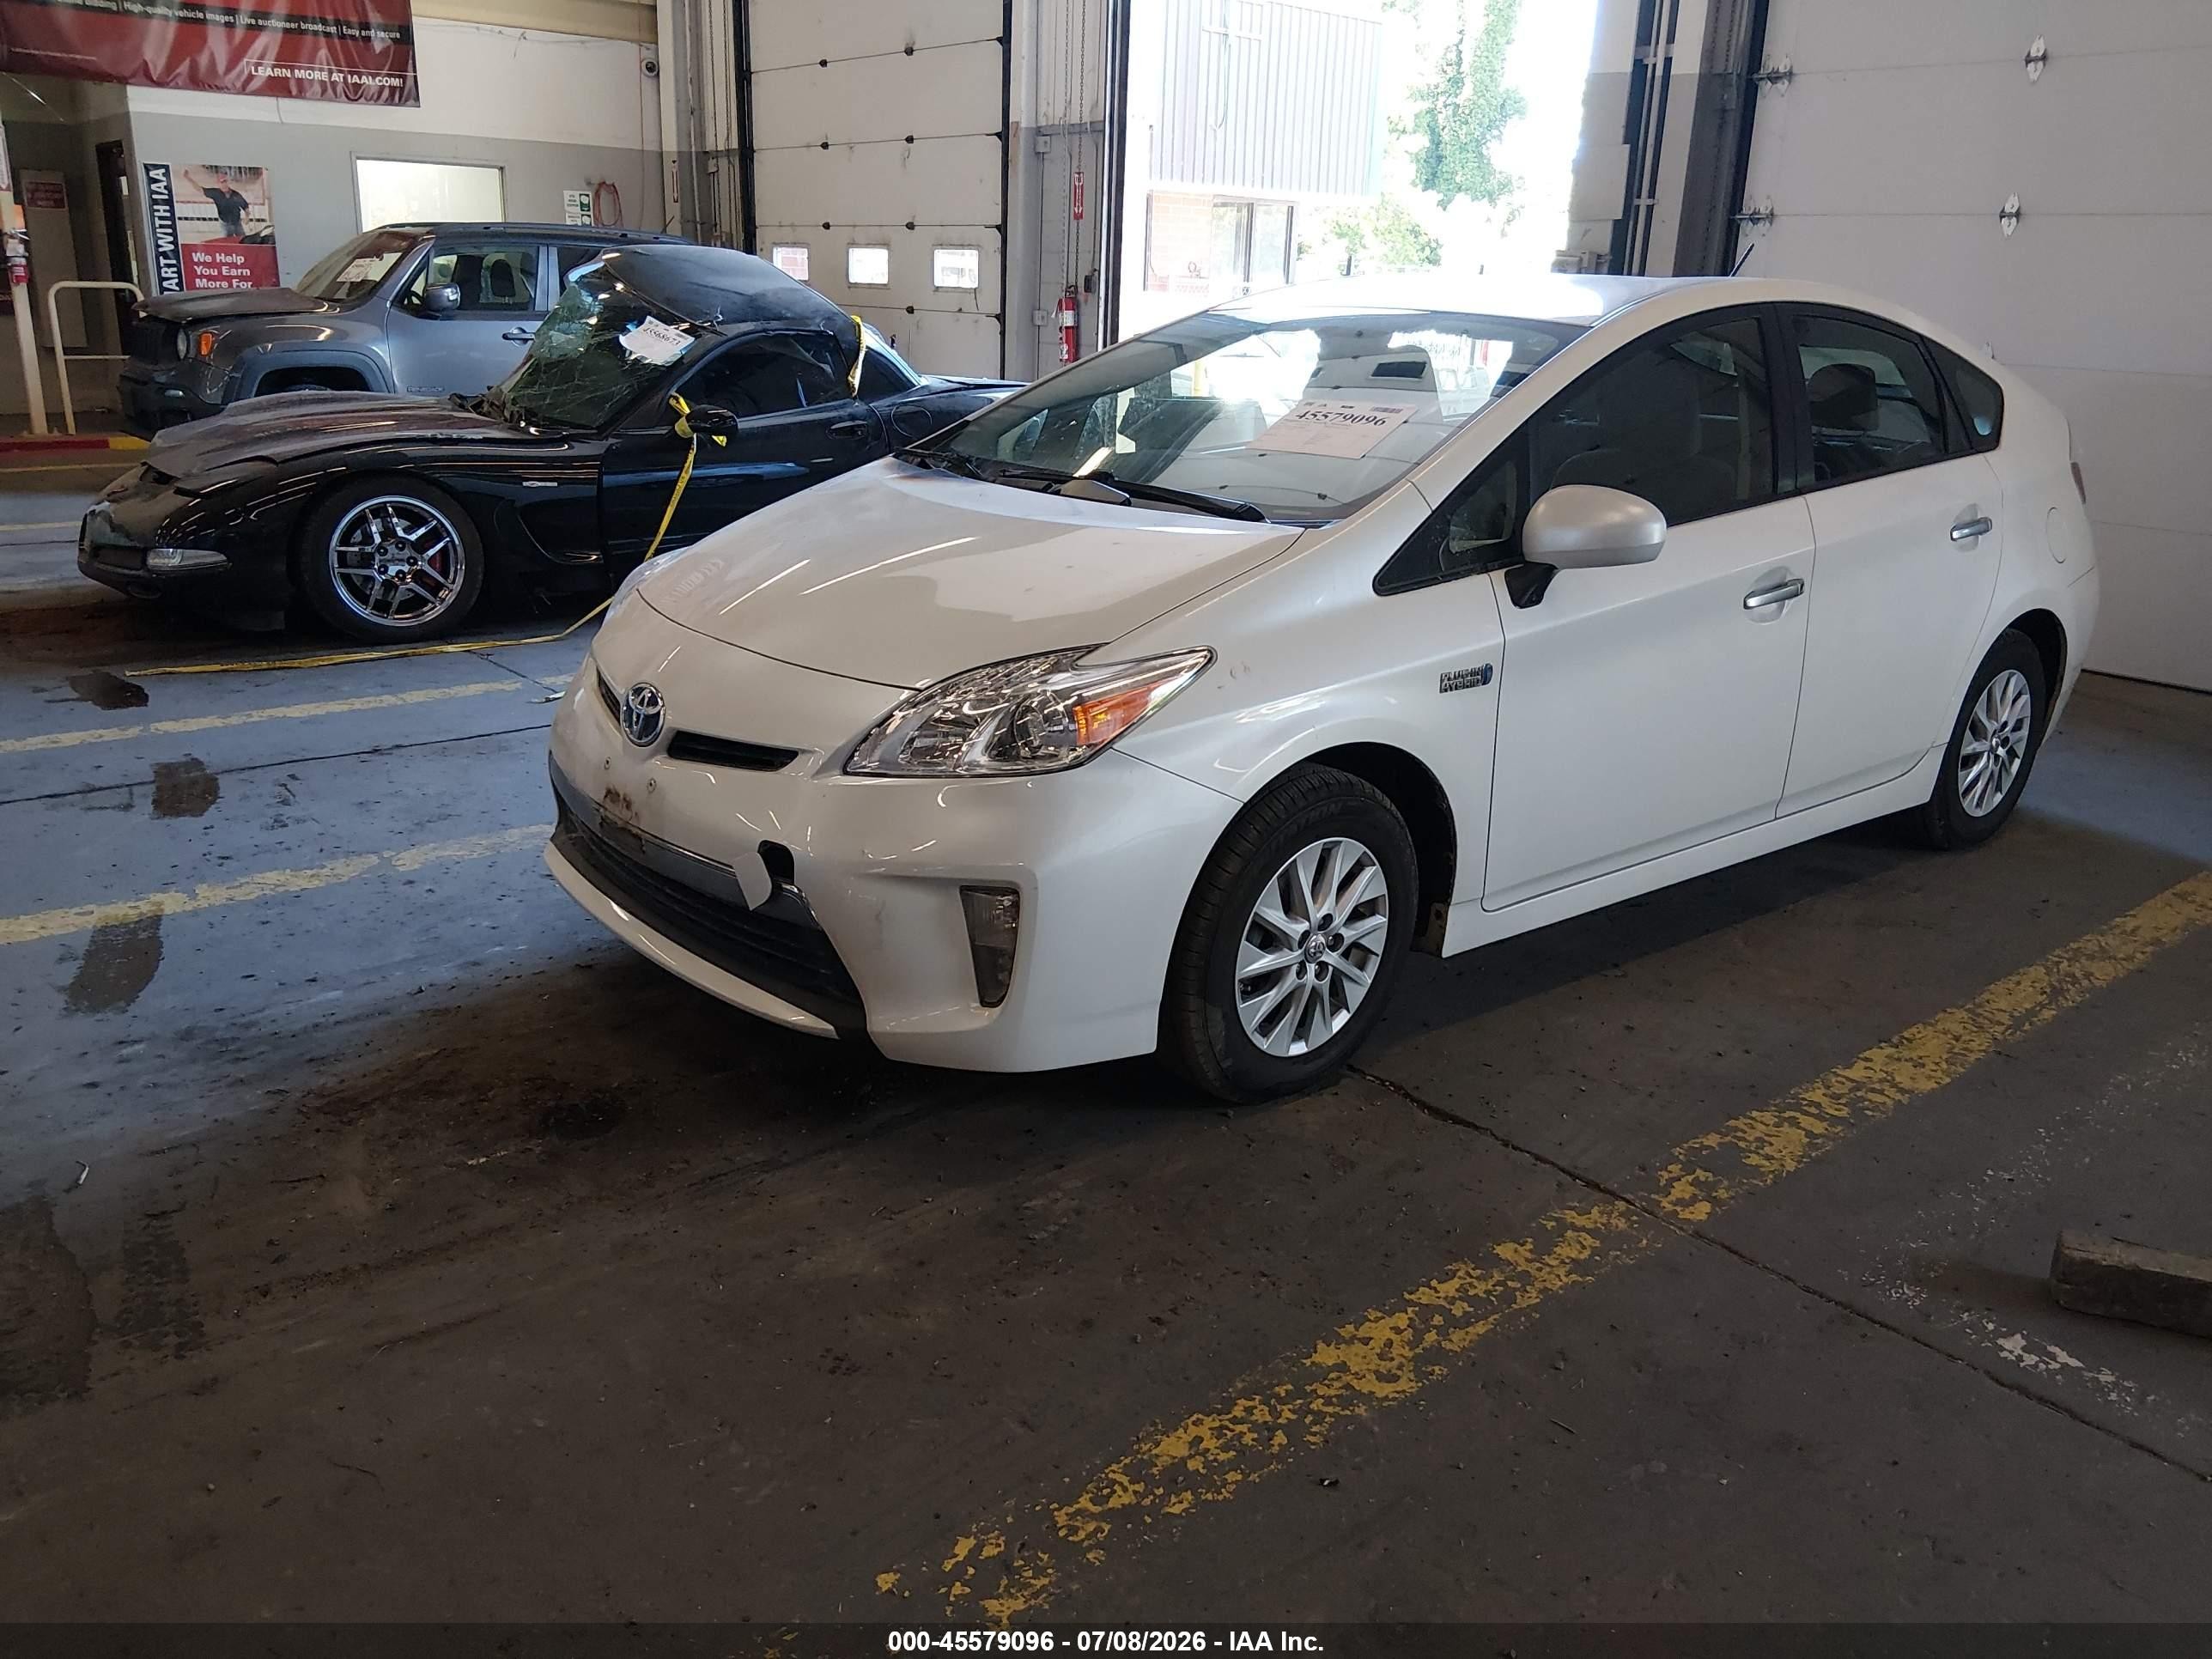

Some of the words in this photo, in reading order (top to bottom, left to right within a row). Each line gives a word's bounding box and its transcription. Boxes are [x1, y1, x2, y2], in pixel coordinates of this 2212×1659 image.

[174, 8, 204, 19] vehicle
[206, 12, 234, 23] images
[240, 15, 256, 24] Live
[258, 18, 299, 28] auctioneer
[301, 21, 337, 33] broadcast
[343, 26, 359, 37] Easy
[251, 66, 291, 78] LEARN
[295, 69, 328, 81] MORE
[331, 74, 343, 83] AT
[149, 167, 169, 199] IAA
[153, 205, 175, 252] WITH
[191, 252, 212, 263] We
[216, 252, 245, 265] Help
[159, 256, 180, 295] ART
[193, 265, 218, 276] You
[222, 265, 251, 276] Earn
[195, 278, 228, 289] More
[232, 278, 253, 289] For
[1296, 410, 1389, 427] 45579096
